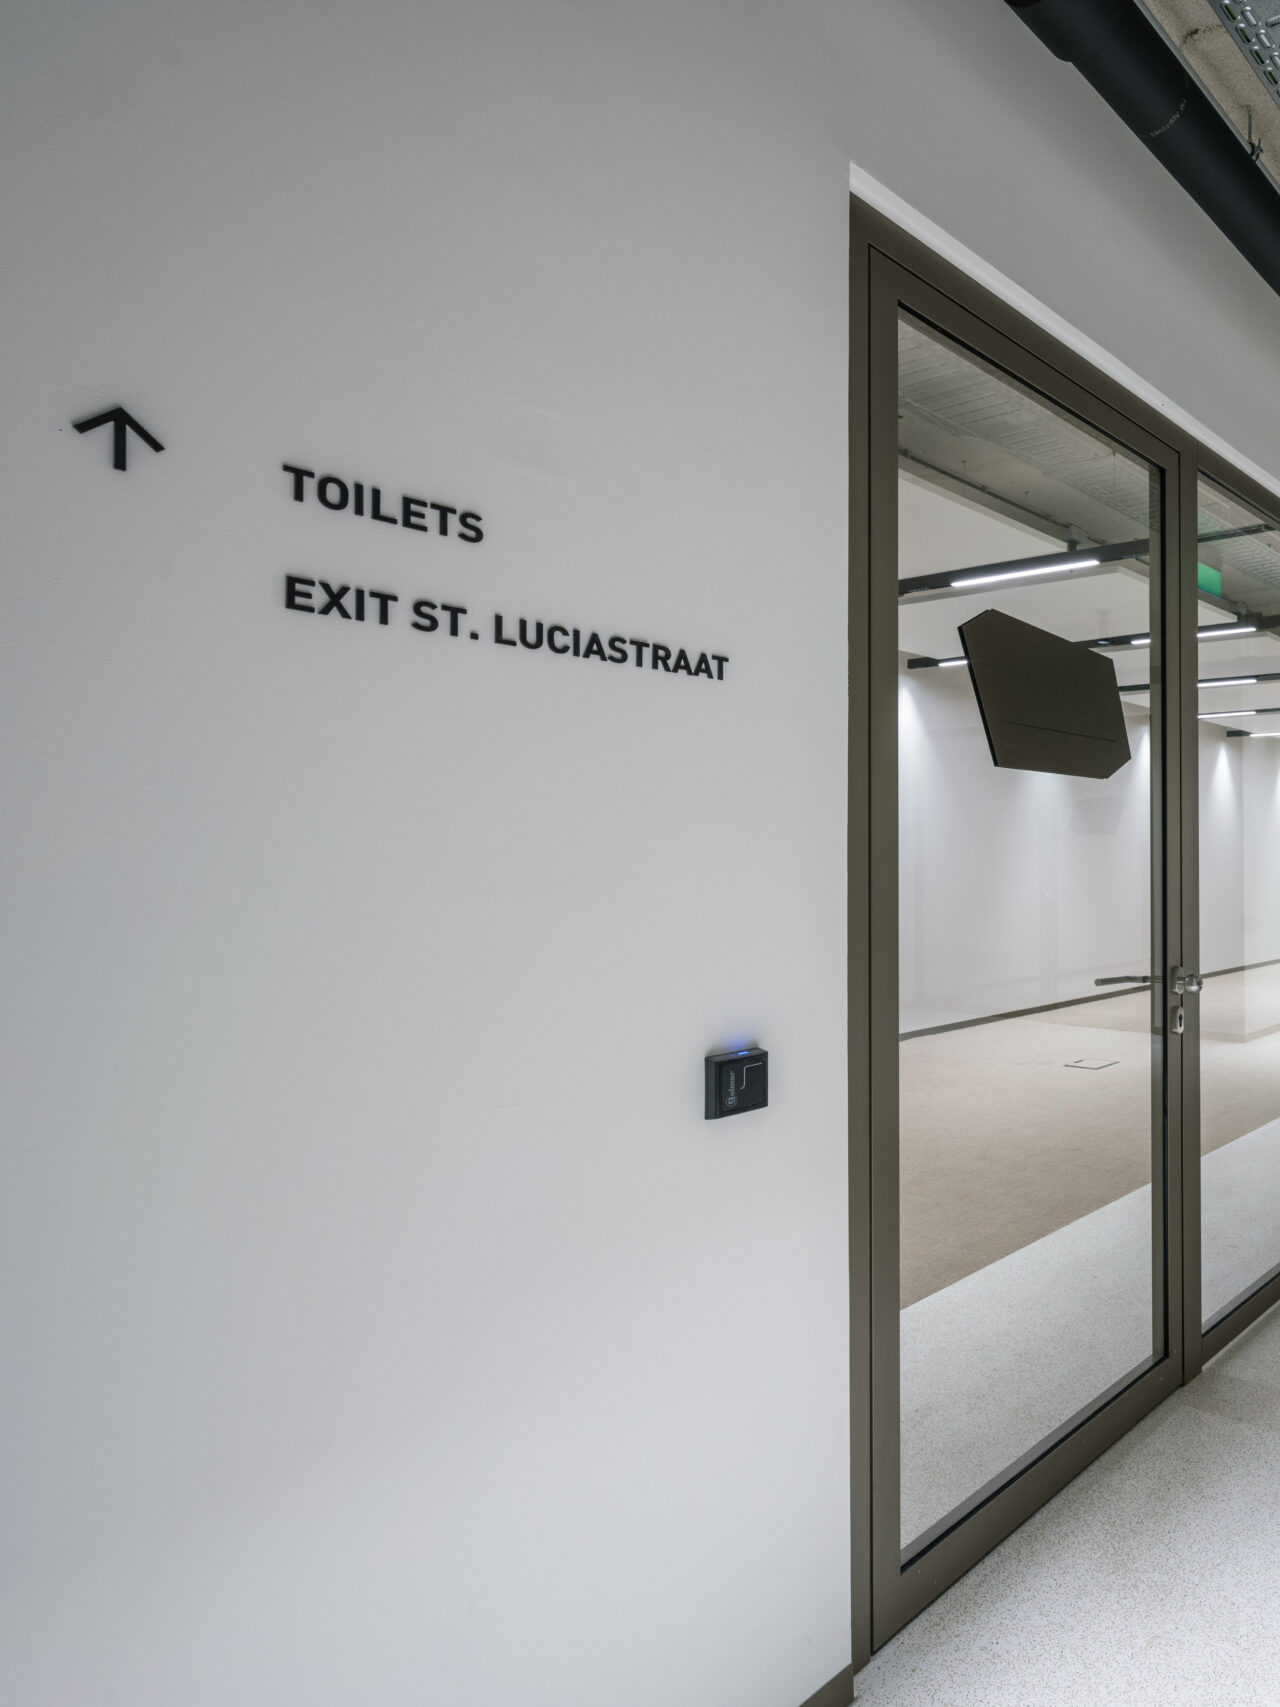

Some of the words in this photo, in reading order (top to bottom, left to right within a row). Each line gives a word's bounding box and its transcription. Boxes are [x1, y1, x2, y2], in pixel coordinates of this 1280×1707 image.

[281, 463, 485, 545] TOILETS
[284, 574, 399, 626] EXIT
[410, 599, 480, 641] ST.
[494, 612, 730, 681] LUCIASTRAAT
